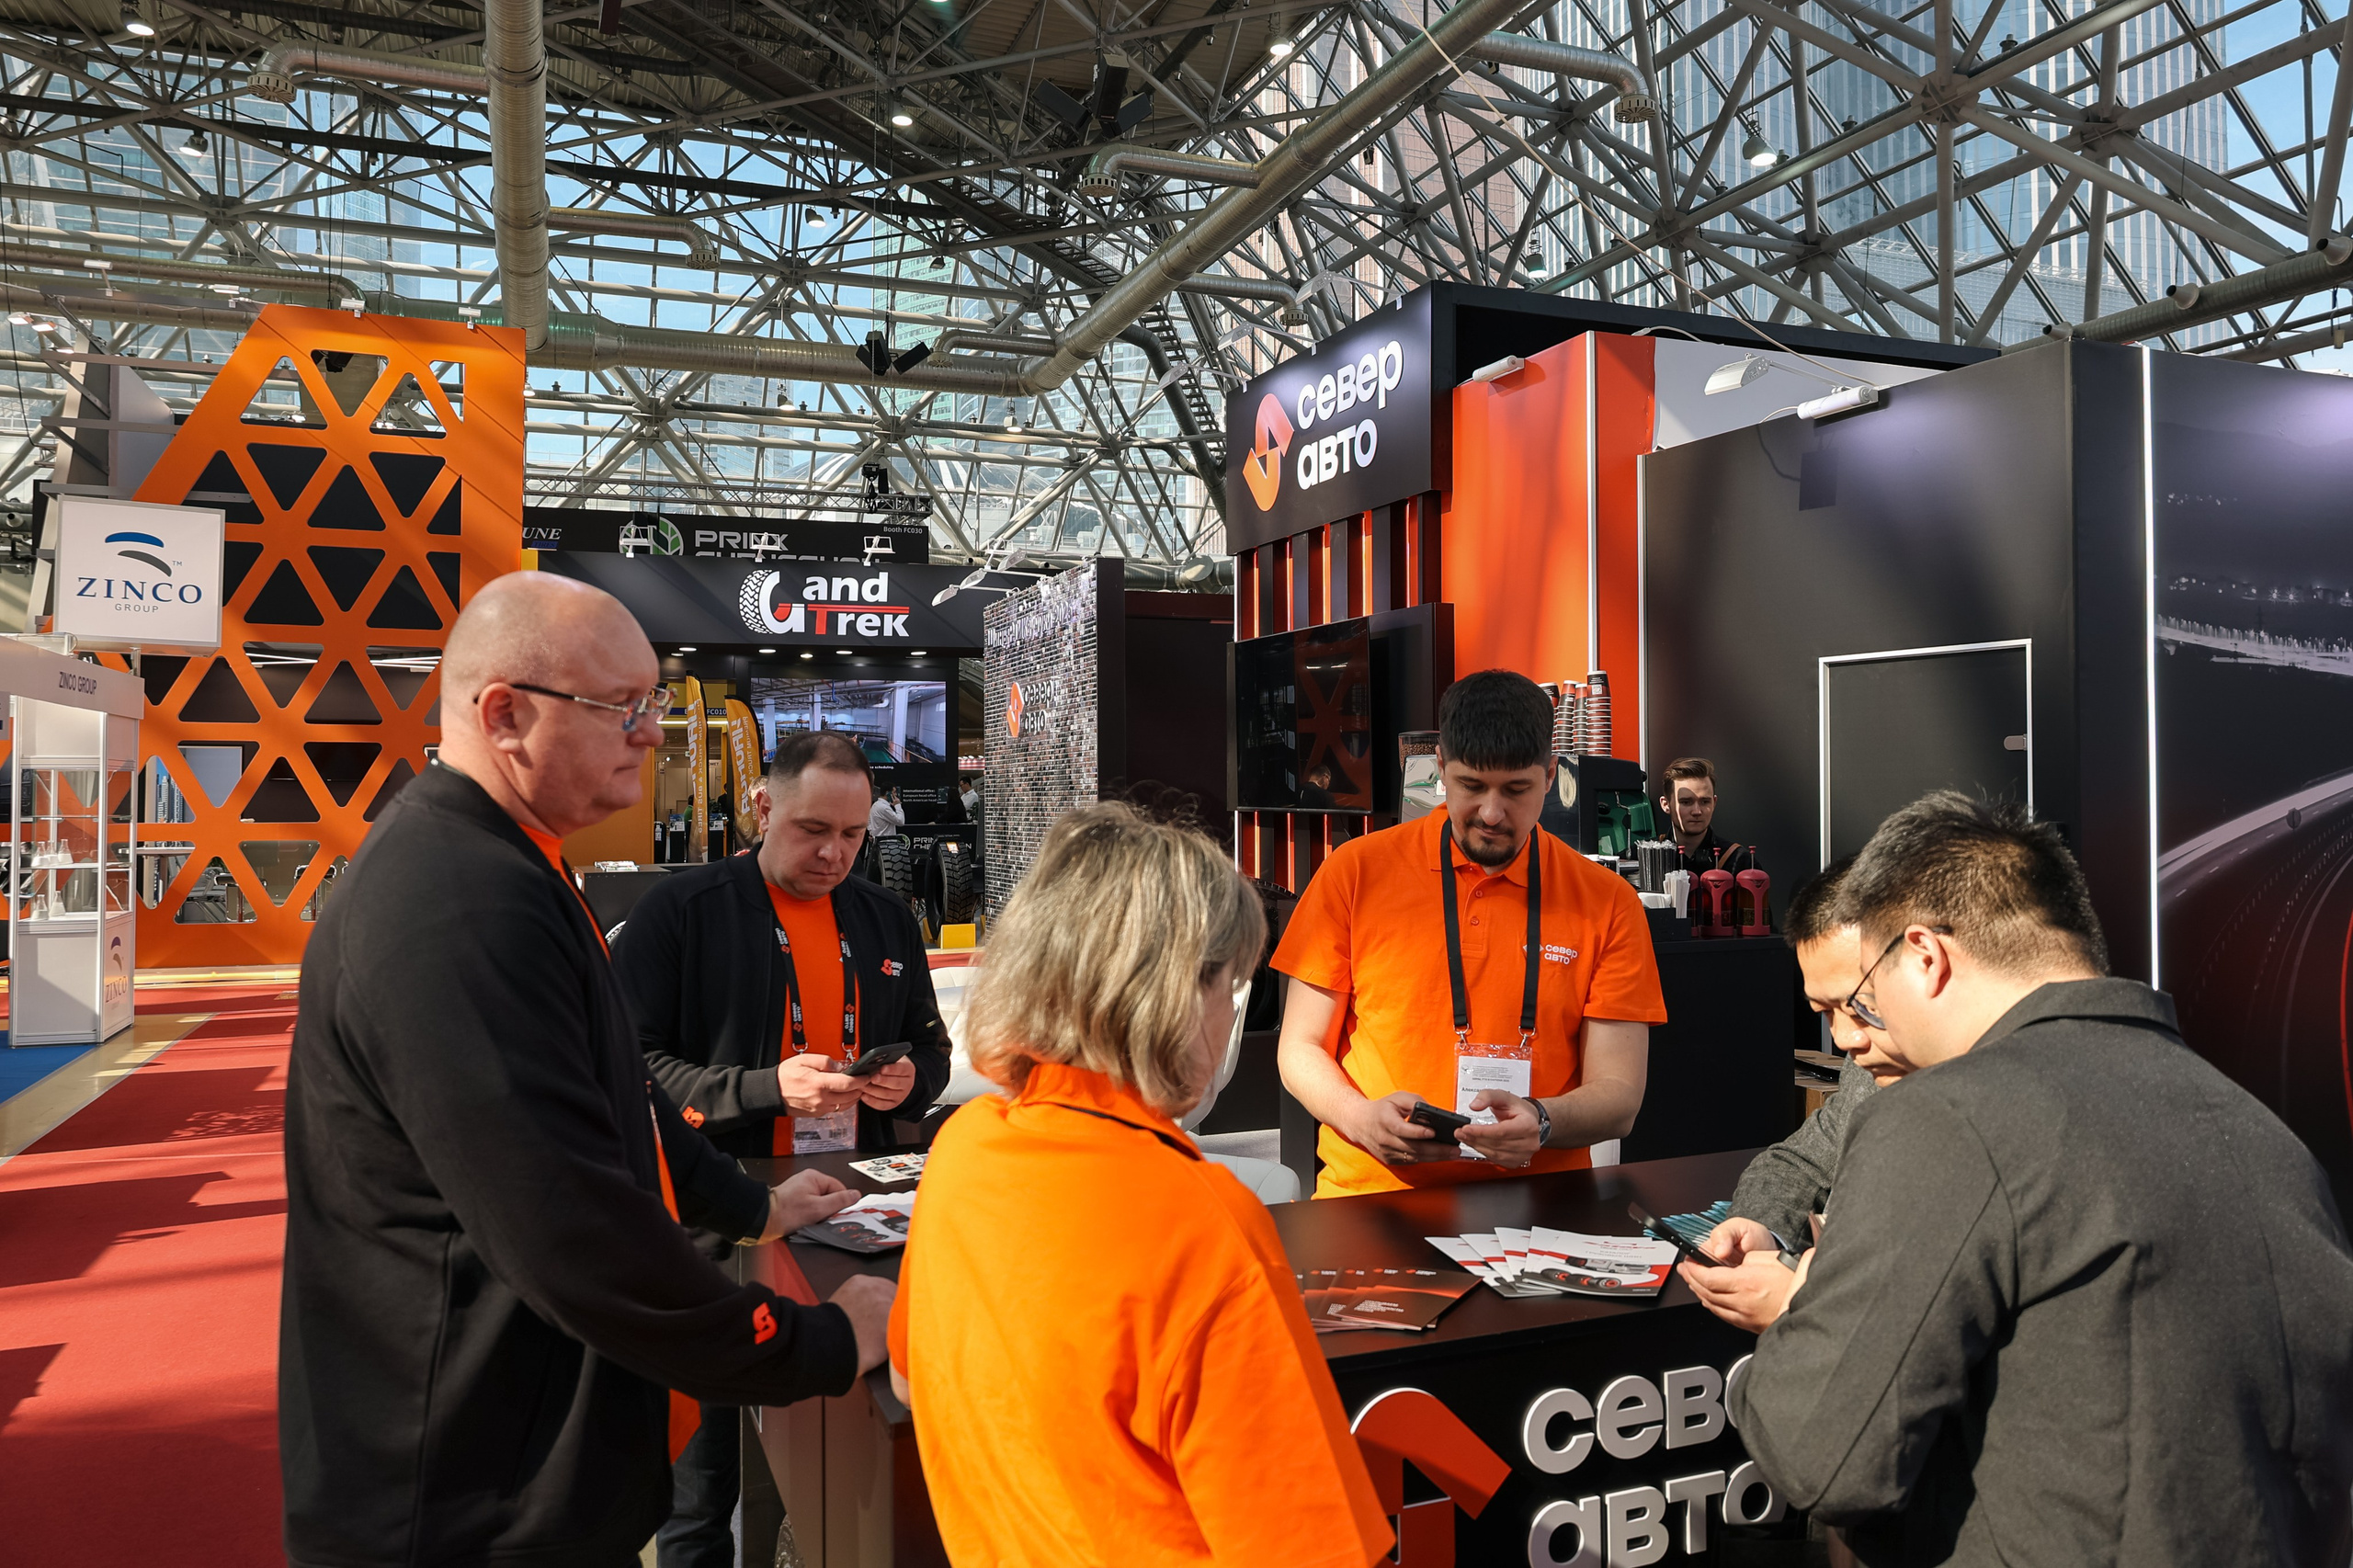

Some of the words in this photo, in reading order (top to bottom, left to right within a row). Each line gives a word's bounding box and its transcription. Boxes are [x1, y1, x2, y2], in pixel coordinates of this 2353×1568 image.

[1297, 340, 1404, 430] север
[1297, 418, 1378, 490] авто
[76, 576, 202, 604] ZINCO
[115, 603, 159, 613] GROUP
[59, 671, 76, 691] ZINCO
[77, 676, 97, 695] GROUP
[1544, 952, 1570, 965] авто
[1545, 944, 1578, 960] север
[106, 975, 127, 1003] ZINCO
[1523, 1354, 1754, 1474] сев
